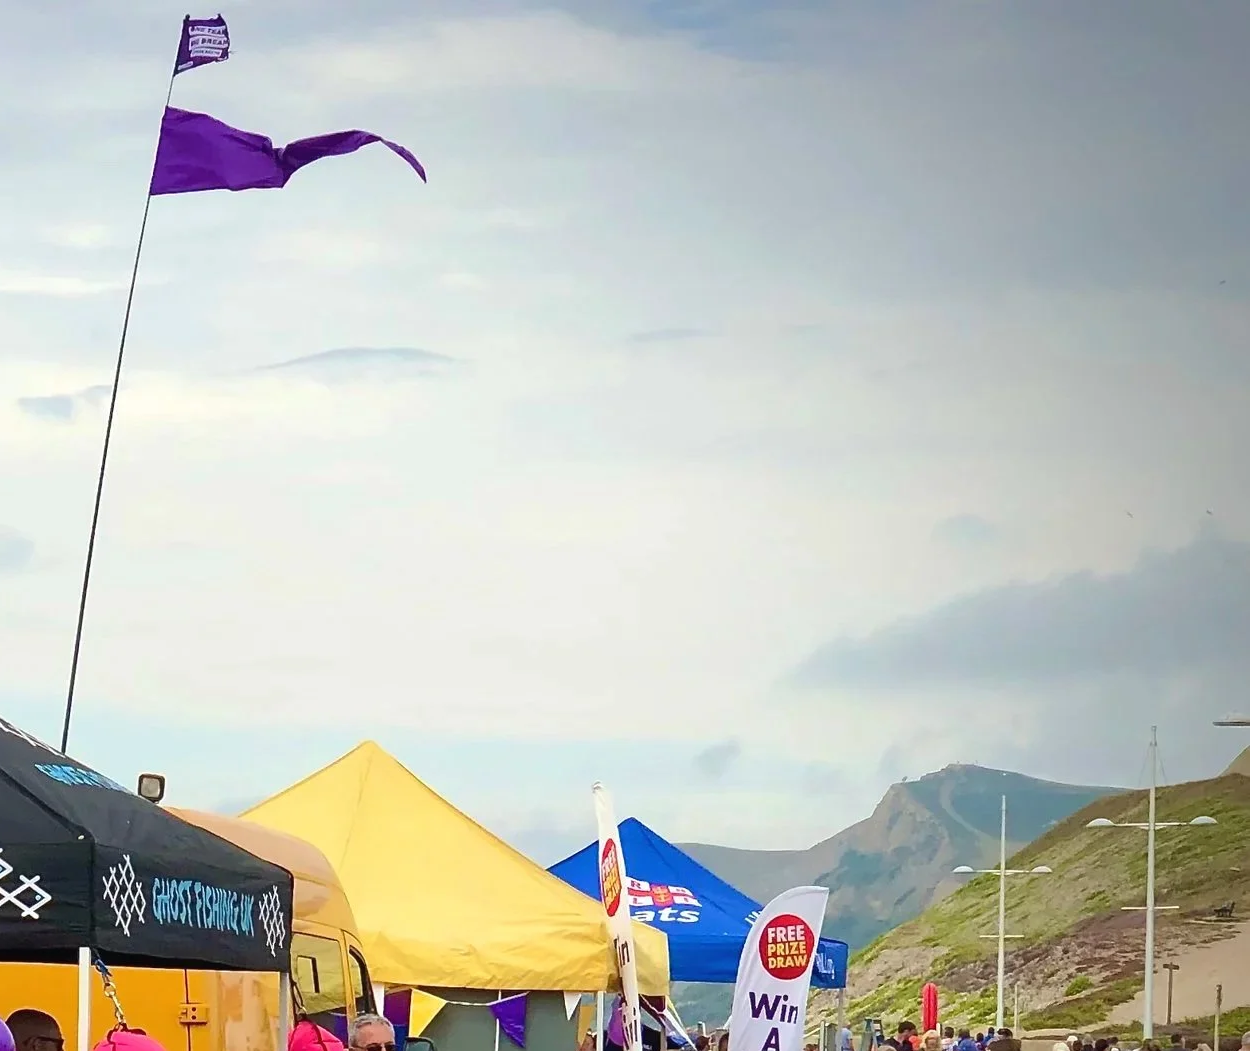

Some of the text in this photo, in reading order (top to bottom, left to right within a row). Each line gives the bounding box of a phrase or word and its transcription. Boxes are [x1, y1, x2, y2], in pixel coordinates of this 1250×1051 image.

[152, 877, 254, 938] GHOST FISHING UK
[767, 924, 806, 944] FREE
[767, 941, 807, 957] PRIZE
[768, 955, 807, 969] DRAW
[748, 991, 799, 1025] Win
